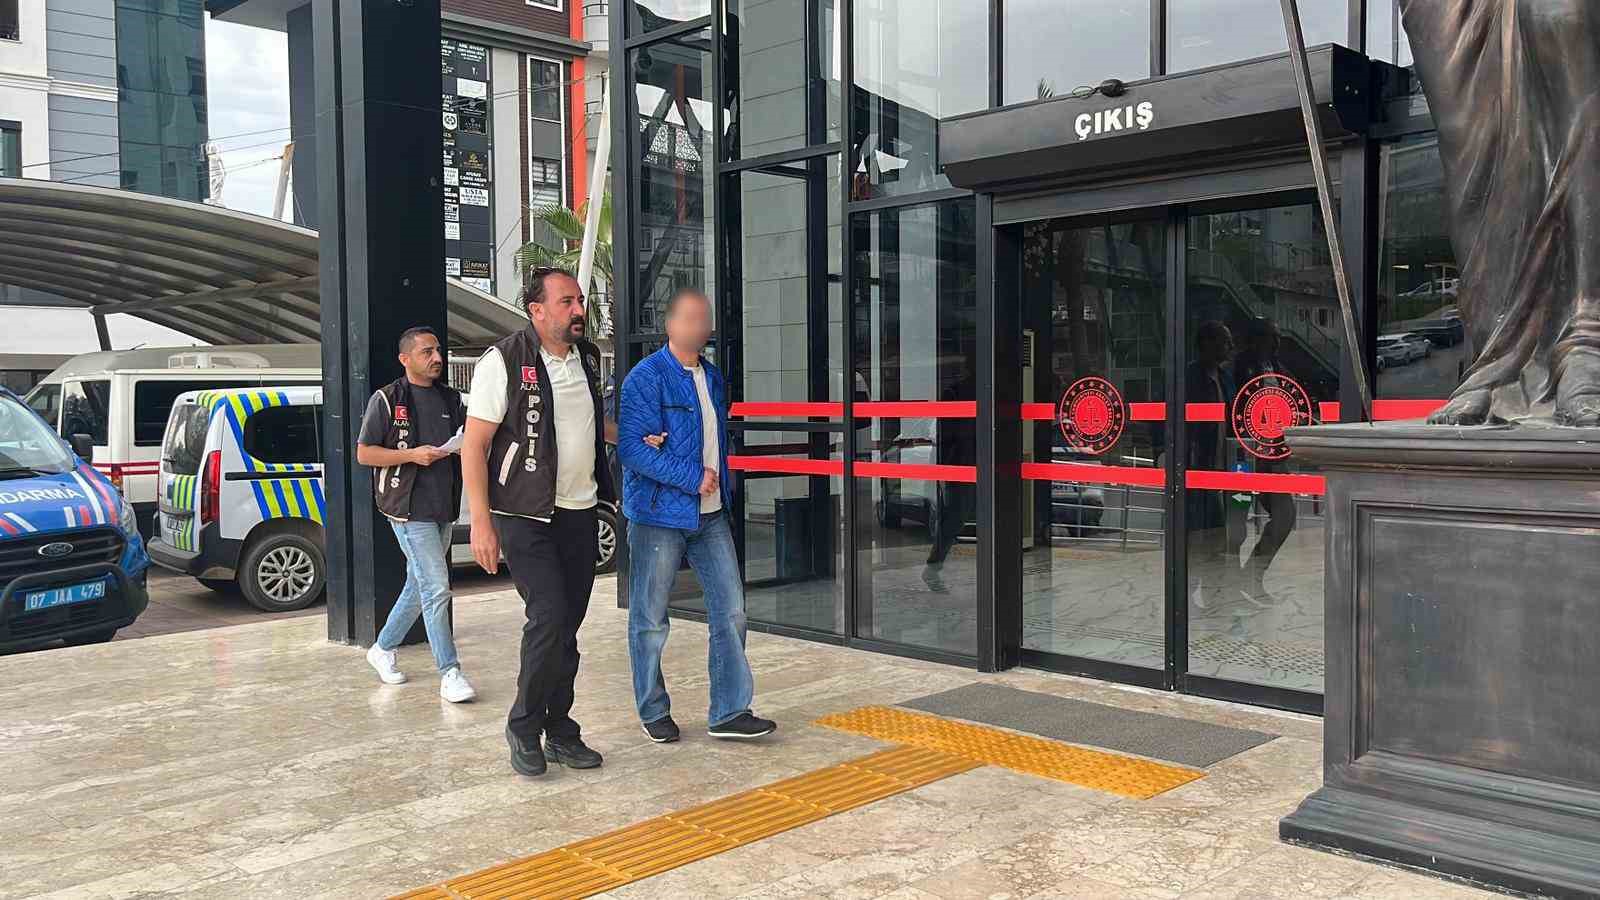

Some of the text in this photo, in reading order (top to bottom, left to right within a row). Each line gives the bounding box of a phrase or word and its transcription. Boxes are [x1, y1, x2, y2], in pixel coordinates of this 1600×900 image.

[1074, 101, 1154, 140] ÇIKIŞ
[31, 593, 46, 607] 07
[51, 588, 73, 605] JAA
